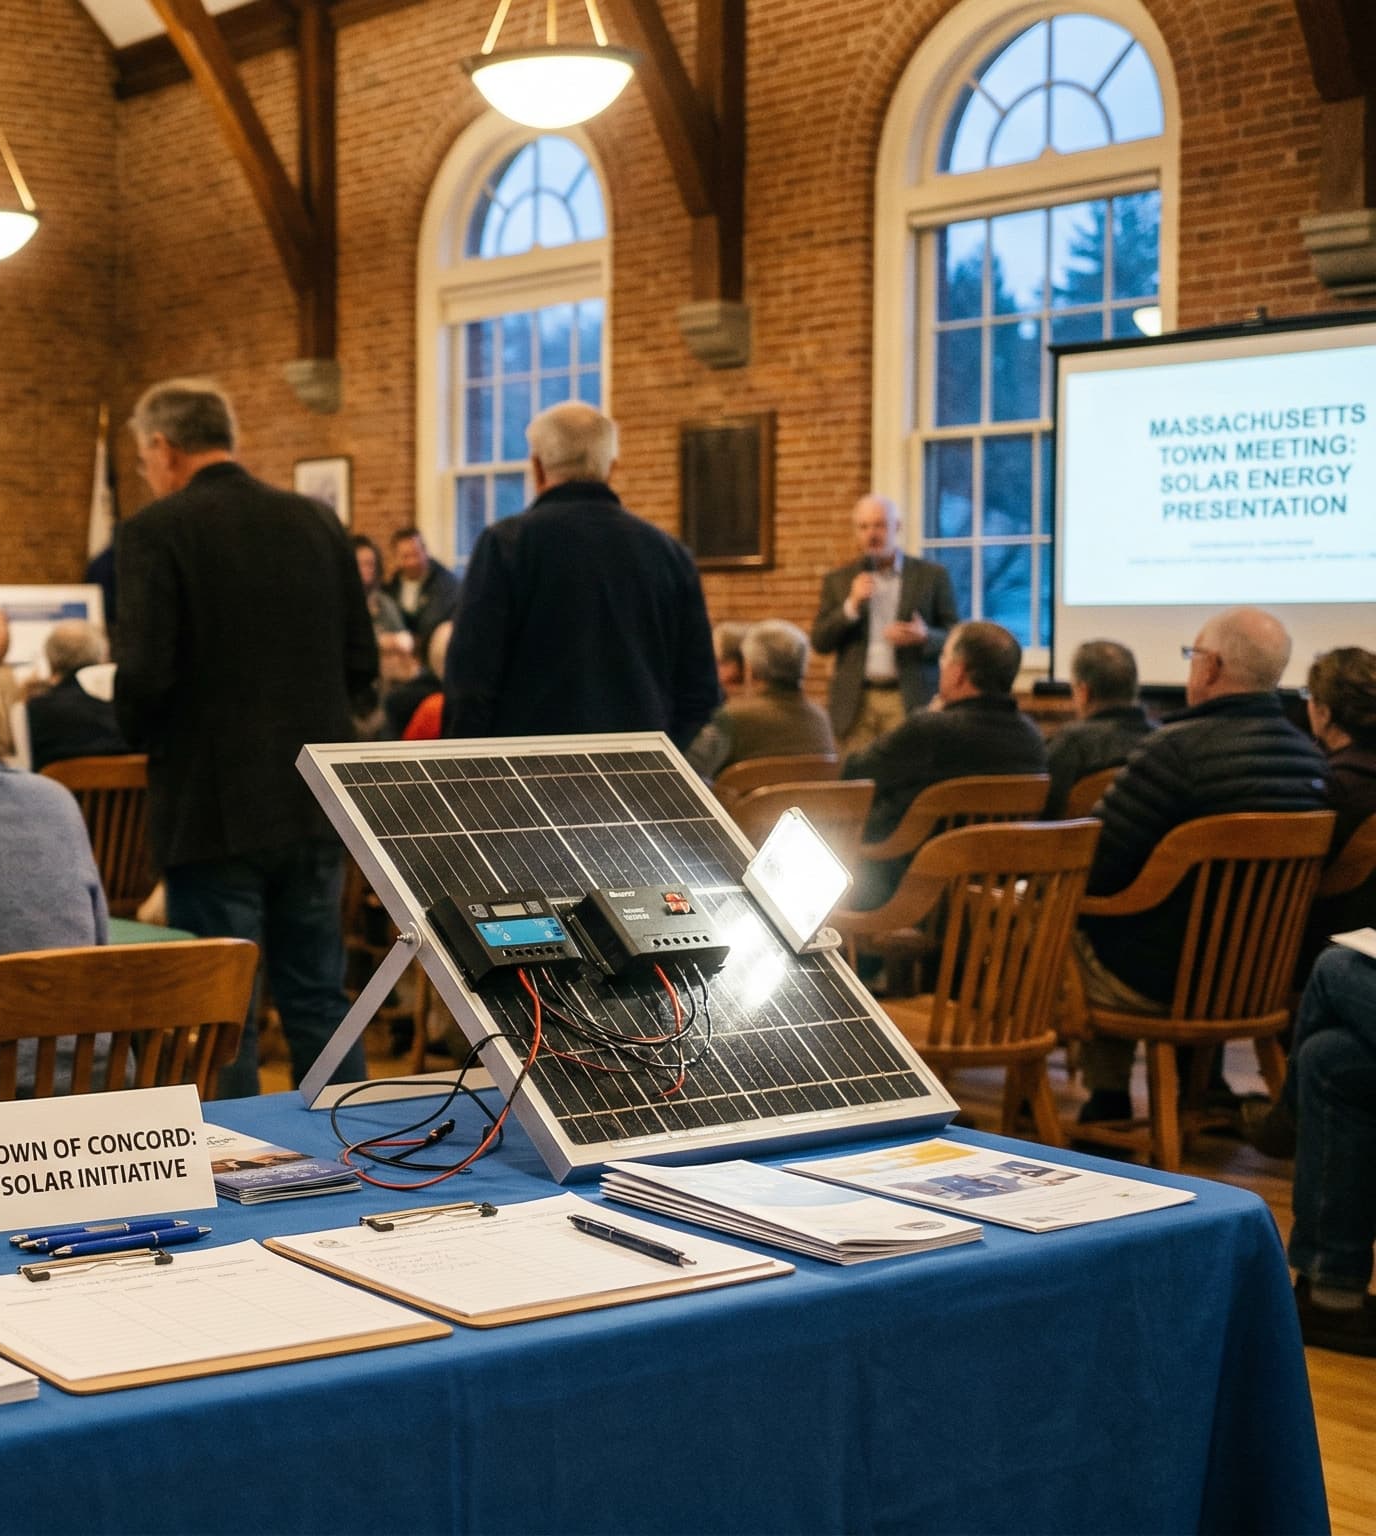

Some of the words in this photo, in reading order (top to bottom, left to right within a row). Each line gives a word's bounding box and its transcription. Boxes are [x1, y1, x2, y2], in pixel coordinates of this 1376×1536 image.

[1150, 403, 1367, 438] MASSACHUSETTS
[1159, 444, 1228, 466] TOWN
[1235, 435, 1357, 462] MEETING:
[1160, 471, 1239, 495] SOLAR
[1248, 464, 1352, 490] ENERGY
[1162, 495, 1348, 522] PRESENTATION
[53, 1137, 81, 1158] OF
[87, 1127, 198, 1155] CONCORD:
[1, 1171, 74, 1196] SOLAR
[78, 1158, 187, 1188] INITIATIVE
